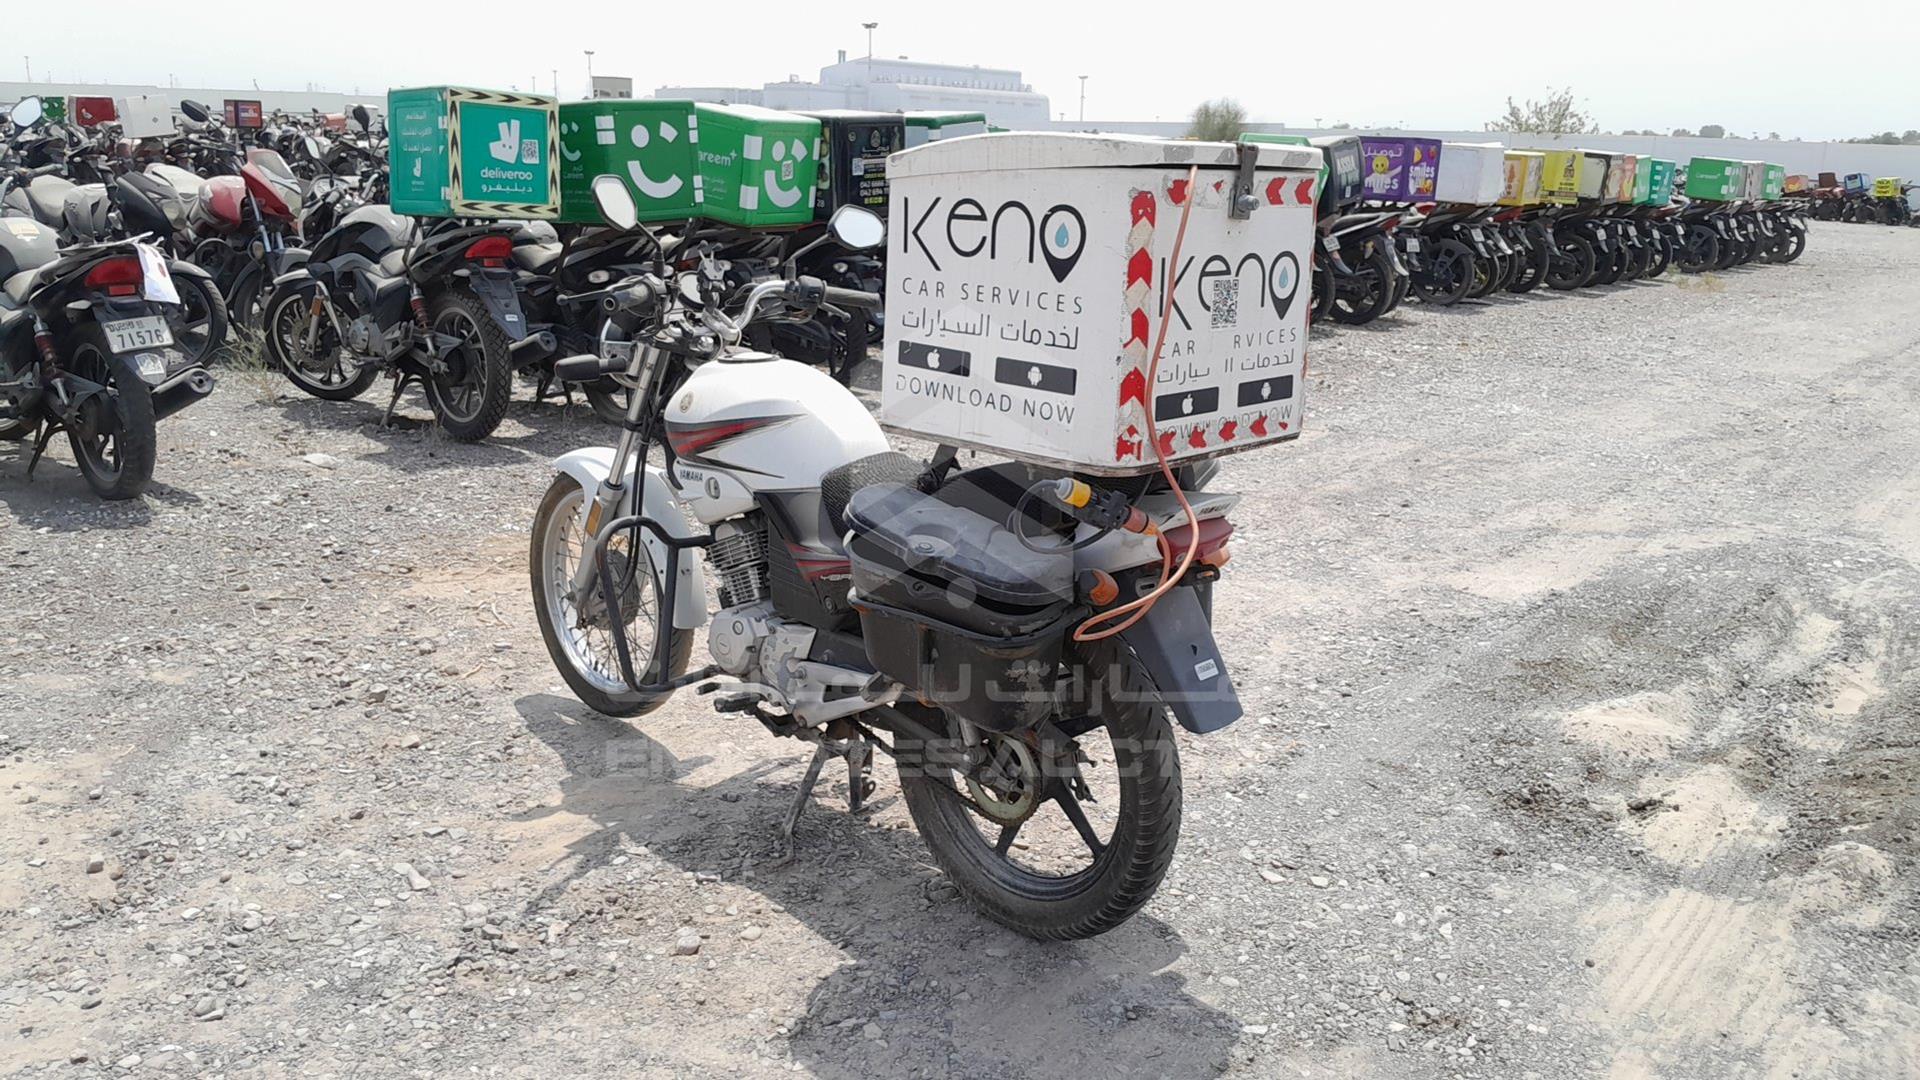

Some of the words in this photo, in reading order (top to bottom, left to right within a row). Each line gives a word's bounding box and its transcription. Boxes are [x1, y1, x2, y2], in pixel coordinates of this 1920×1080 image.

[480, 167, 533, 181] deliveroo
[1364, 177, 1399, 191] miles
[481, 182, 533, 193] ديليفرو
[902, 277, 945, 298] CAR
[960, 283, 1083, 315] SERVICES
[902, 307, 990, 338] السيارات
[117, 329, 164, 348] 71576
[1000, 319, 1079, 350] لخدمات
[1233, 327, 1297, 349] RVICES
[1241, 348, 1294, 371] لخدمات
[896, 373, 1012, 413] DOWNLOAD
[1023, 399, 1075, 424] NOW
[680, 469, 704, 481] YAMAHA
